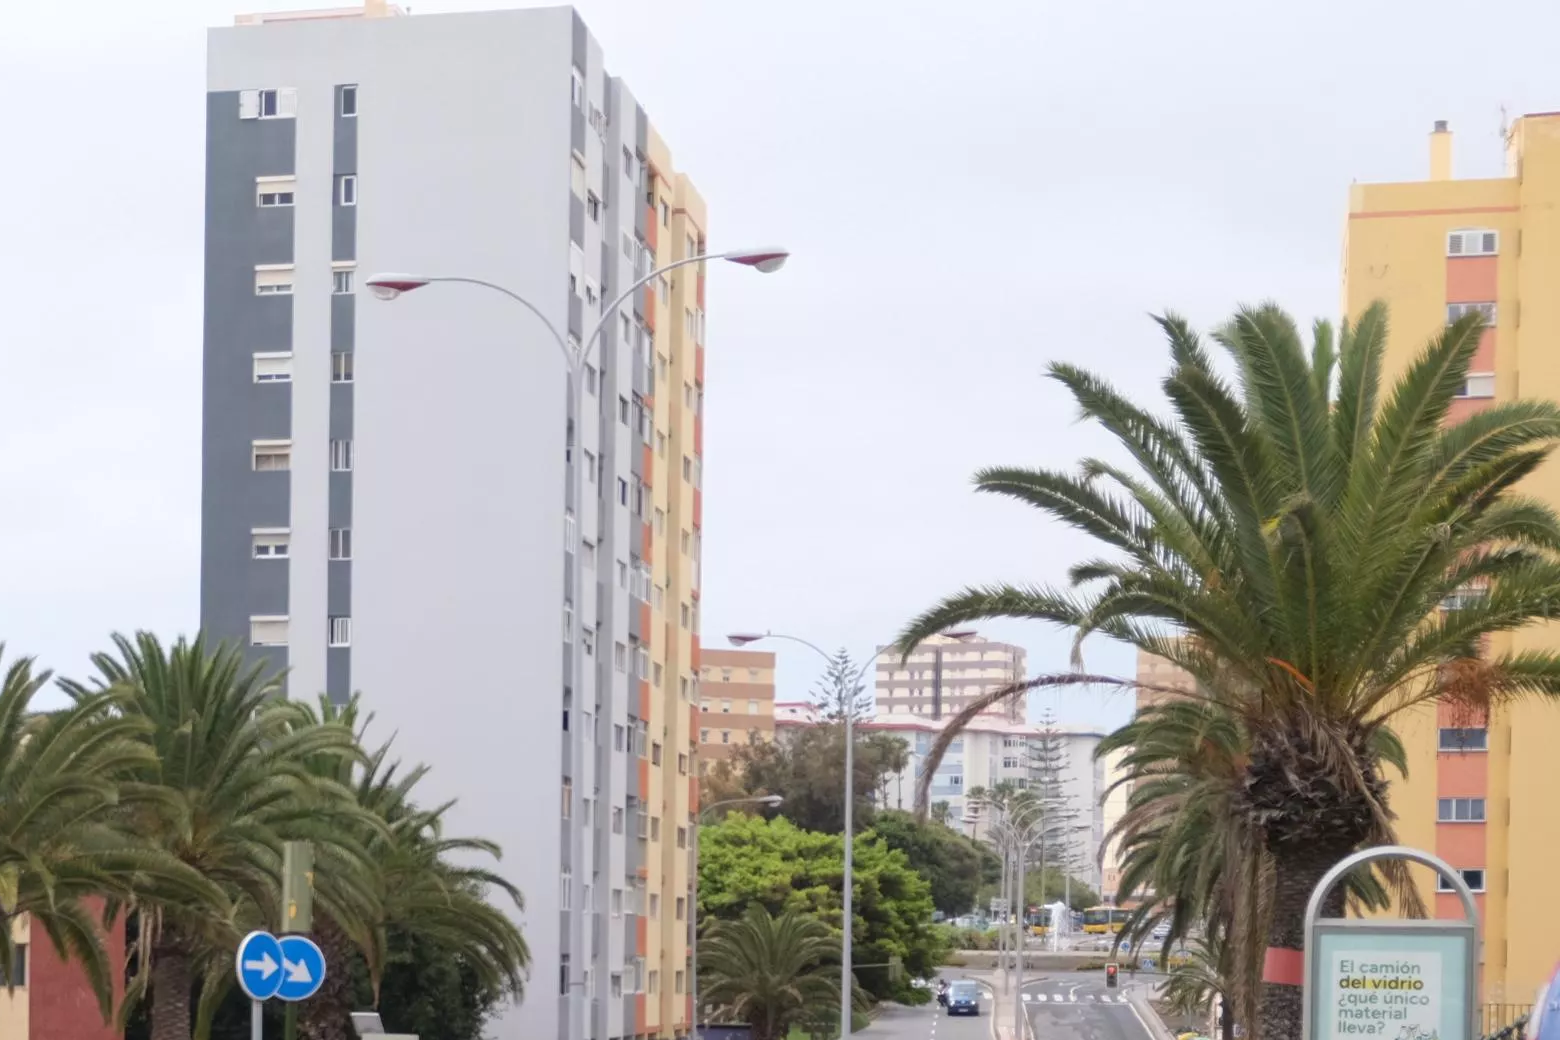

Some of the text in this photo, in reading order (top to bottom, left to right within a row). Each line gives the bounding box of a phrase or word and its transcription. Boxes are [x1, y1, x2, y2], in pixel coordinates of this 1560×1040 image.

[1340, 960, 1421, 974] El camión
[1339, 975, 1424, 990] del vidrio
[1338, 991, 1430, 1007] ¿qué único
[1338, 1006, 1407, 1020] material
[1338, 1020, 1385, 1034] lleva?
